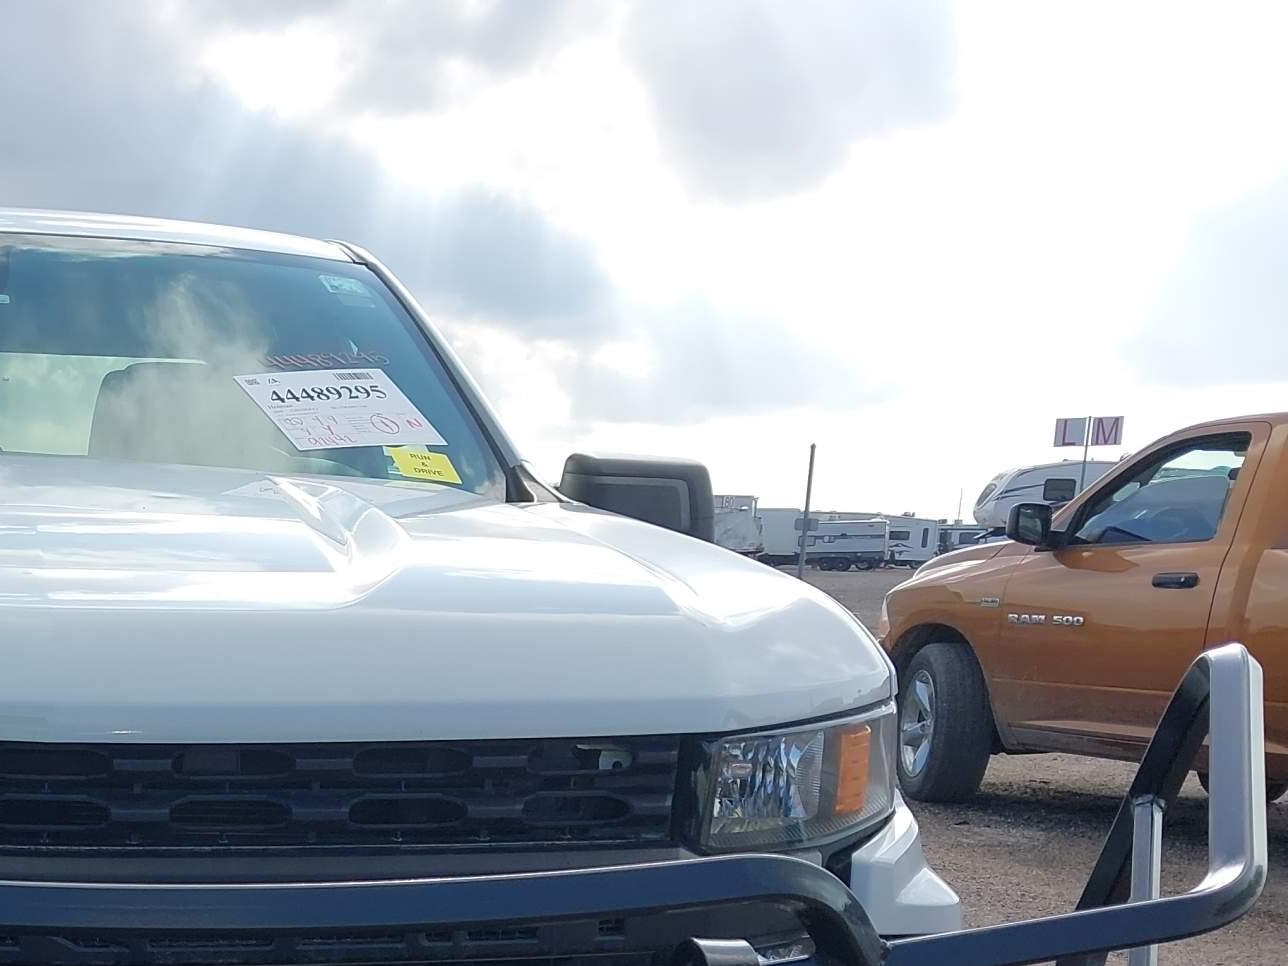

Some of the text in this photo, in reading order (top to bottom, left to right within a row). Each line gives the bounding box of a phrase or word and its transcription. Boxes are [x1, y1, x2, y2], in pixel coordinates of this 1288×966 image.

[271, 384, 387, 403] 44489295
[1095, 418, 1119, 445] M
[409, 453, 432, 461] RUN
[413, 467, 444, 477] DRIVE
[1007, 613, 1085, 626] RAM 500
